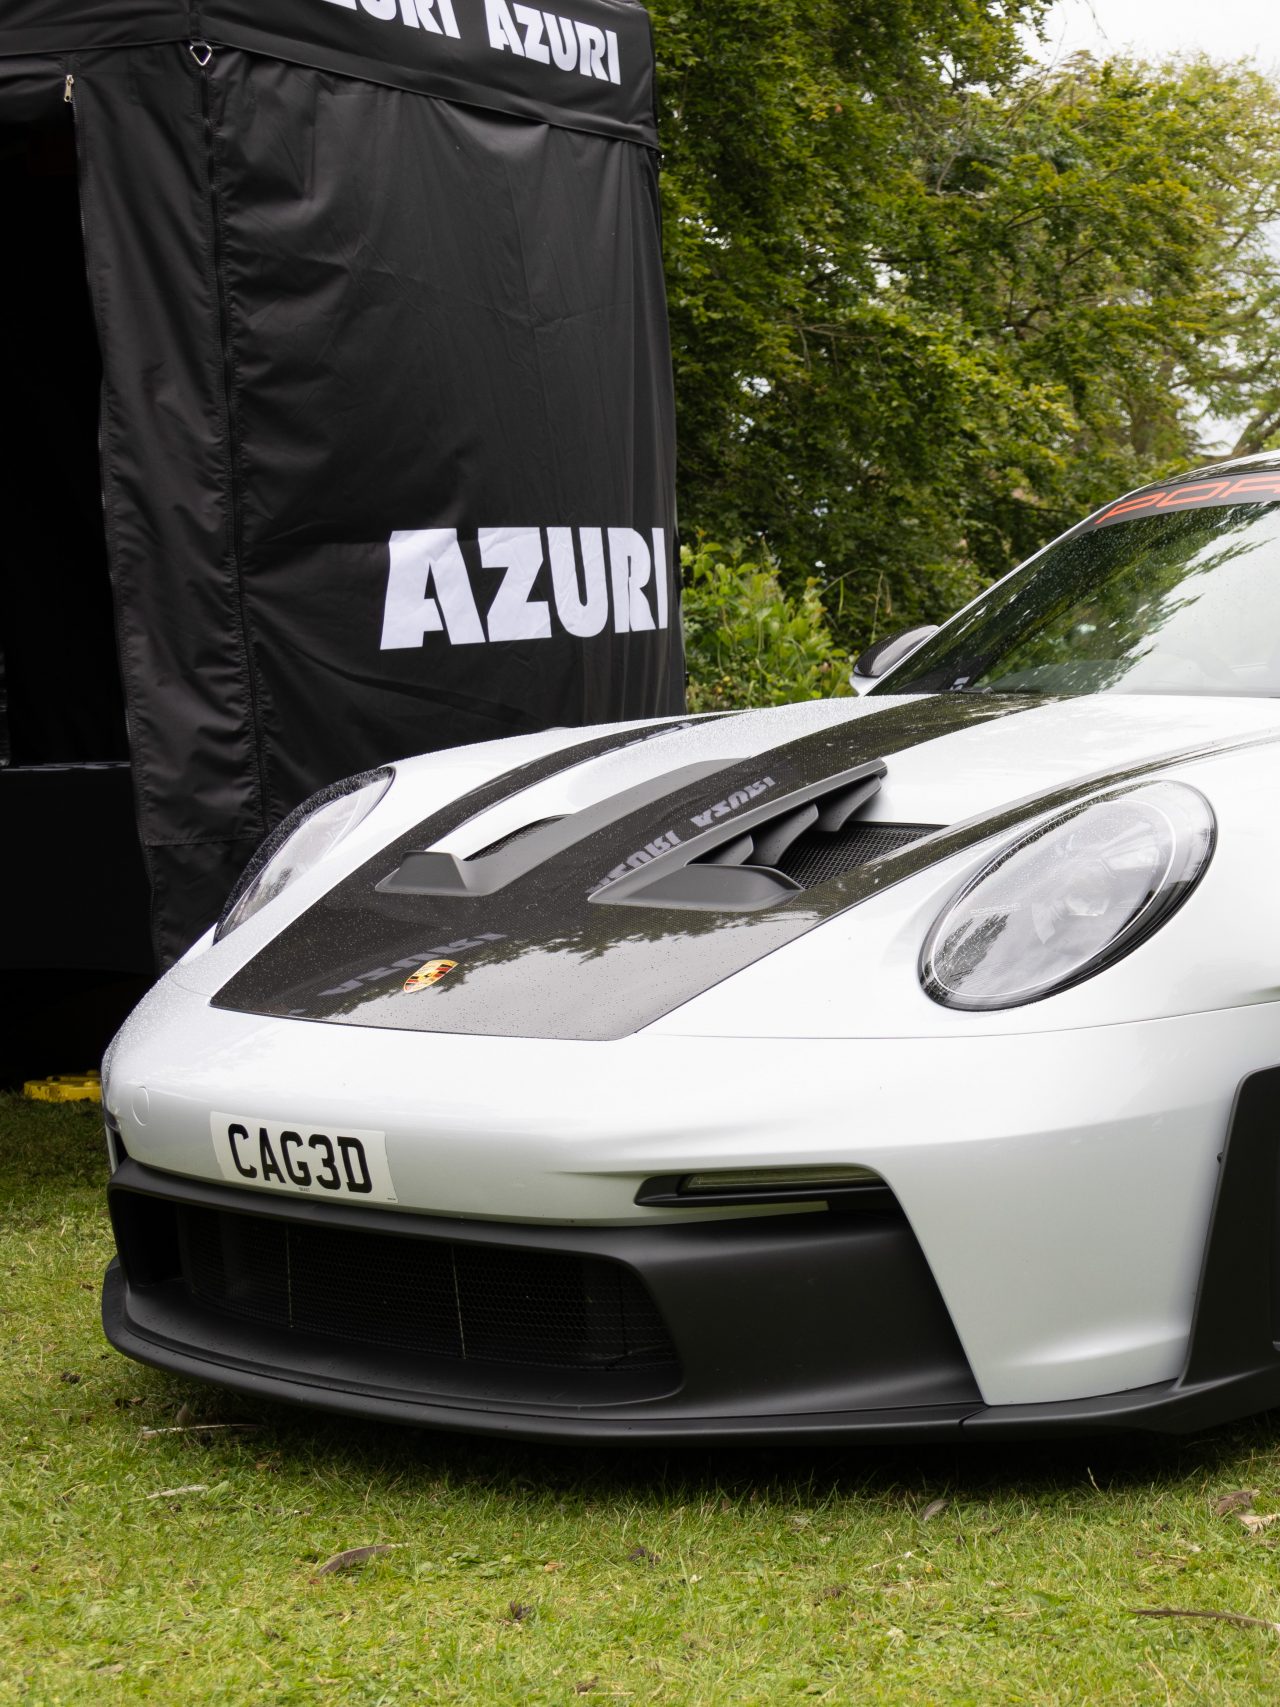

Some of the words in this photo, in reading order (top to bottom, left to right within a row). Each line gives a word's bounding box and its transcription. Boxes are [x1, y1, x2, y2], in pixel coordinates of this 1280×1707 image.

[485, 0, 621, 85] AZURI
[380, 527, 669, 651] AZURI
[228, 1123, 373, 1194] CAG3D
